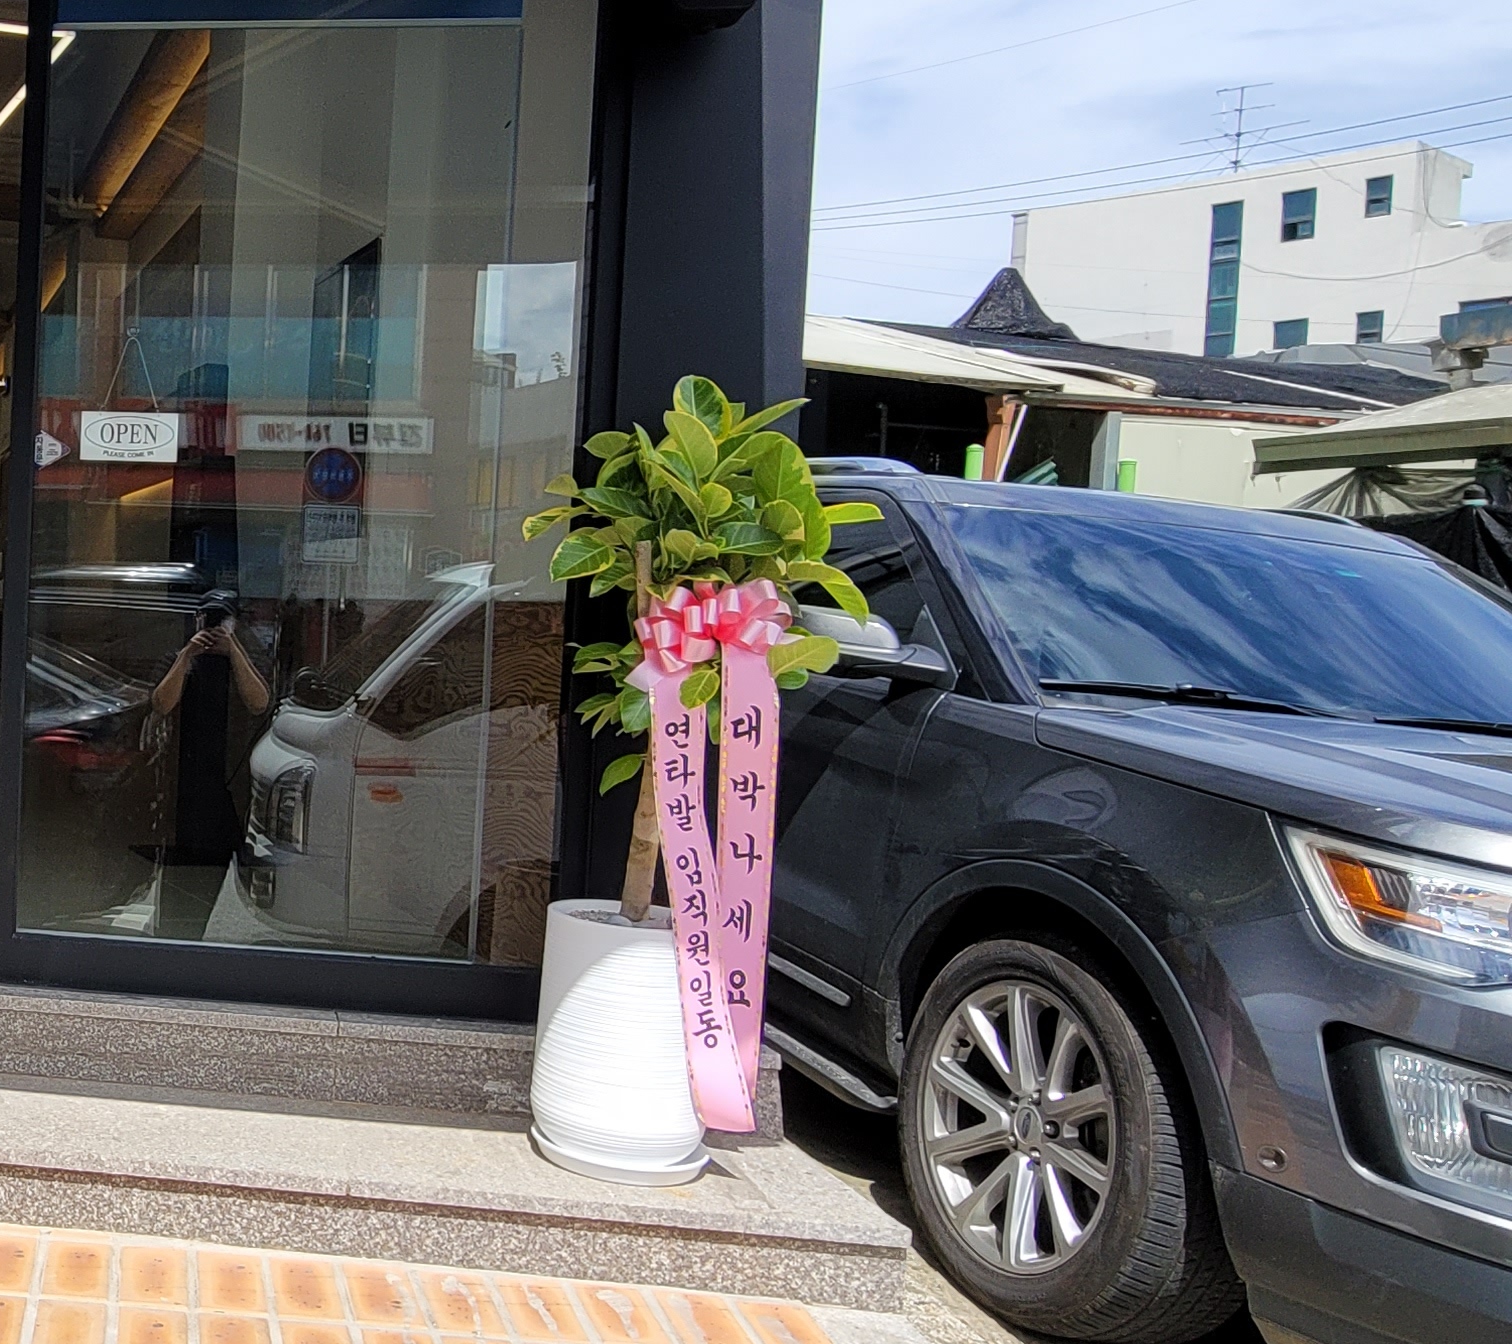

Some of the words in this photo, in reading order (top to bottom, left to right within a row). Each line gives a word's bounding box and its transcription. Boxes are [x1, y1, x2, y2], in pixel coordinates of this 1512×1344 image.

[100, 422, 159, 444] OPEN
[102, 450, 126, 458] PLEASE
[664, 713, 696, 832] 연타발
[722, 705, 765, 1008] 대박나세요
[676, 847, 722, 1049] 임직원일동
